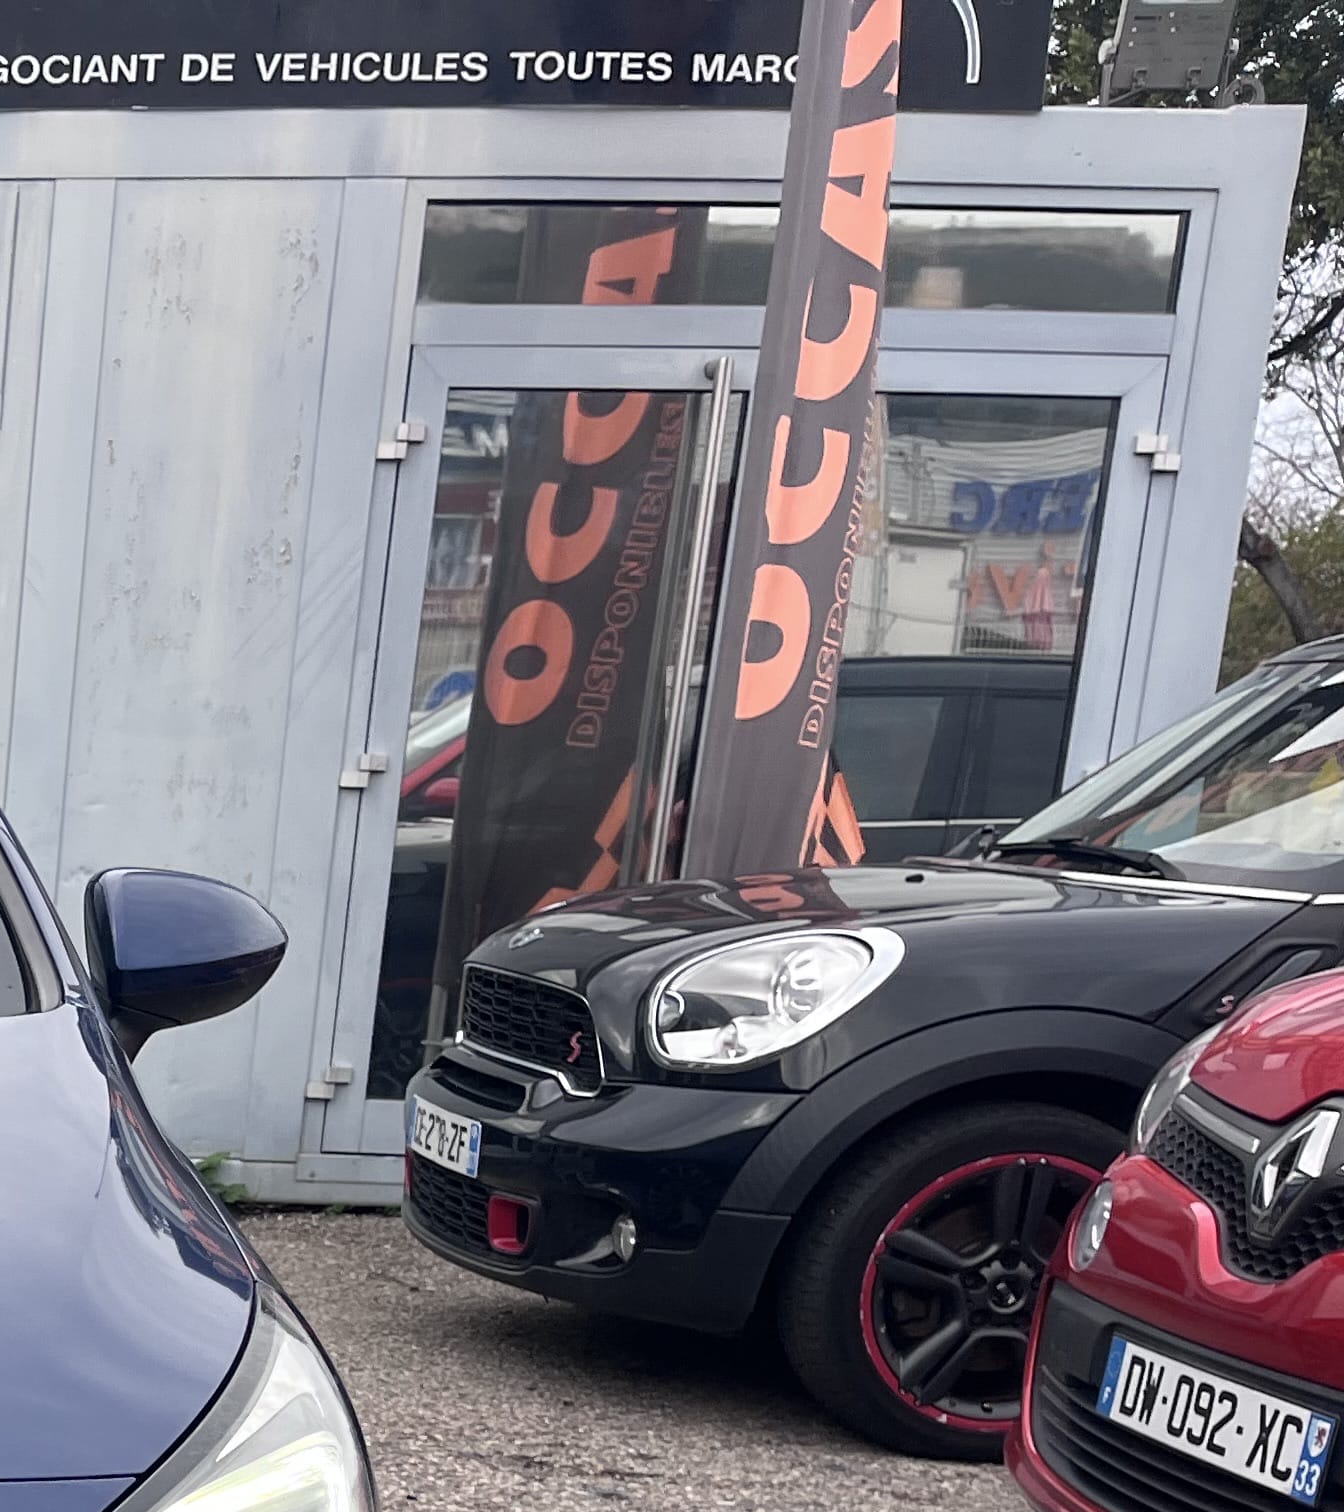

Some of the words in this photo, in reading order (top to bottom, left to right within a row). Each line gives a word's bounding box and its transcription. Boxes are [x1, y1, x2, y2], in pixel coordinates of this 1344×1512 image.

[181, 53, 236, 82] DE
[255, 51, 489, 83] VEHICULES
[509, 51, 673, 82] TOUTES
[1294, 1459, 1321, 1497] 33
